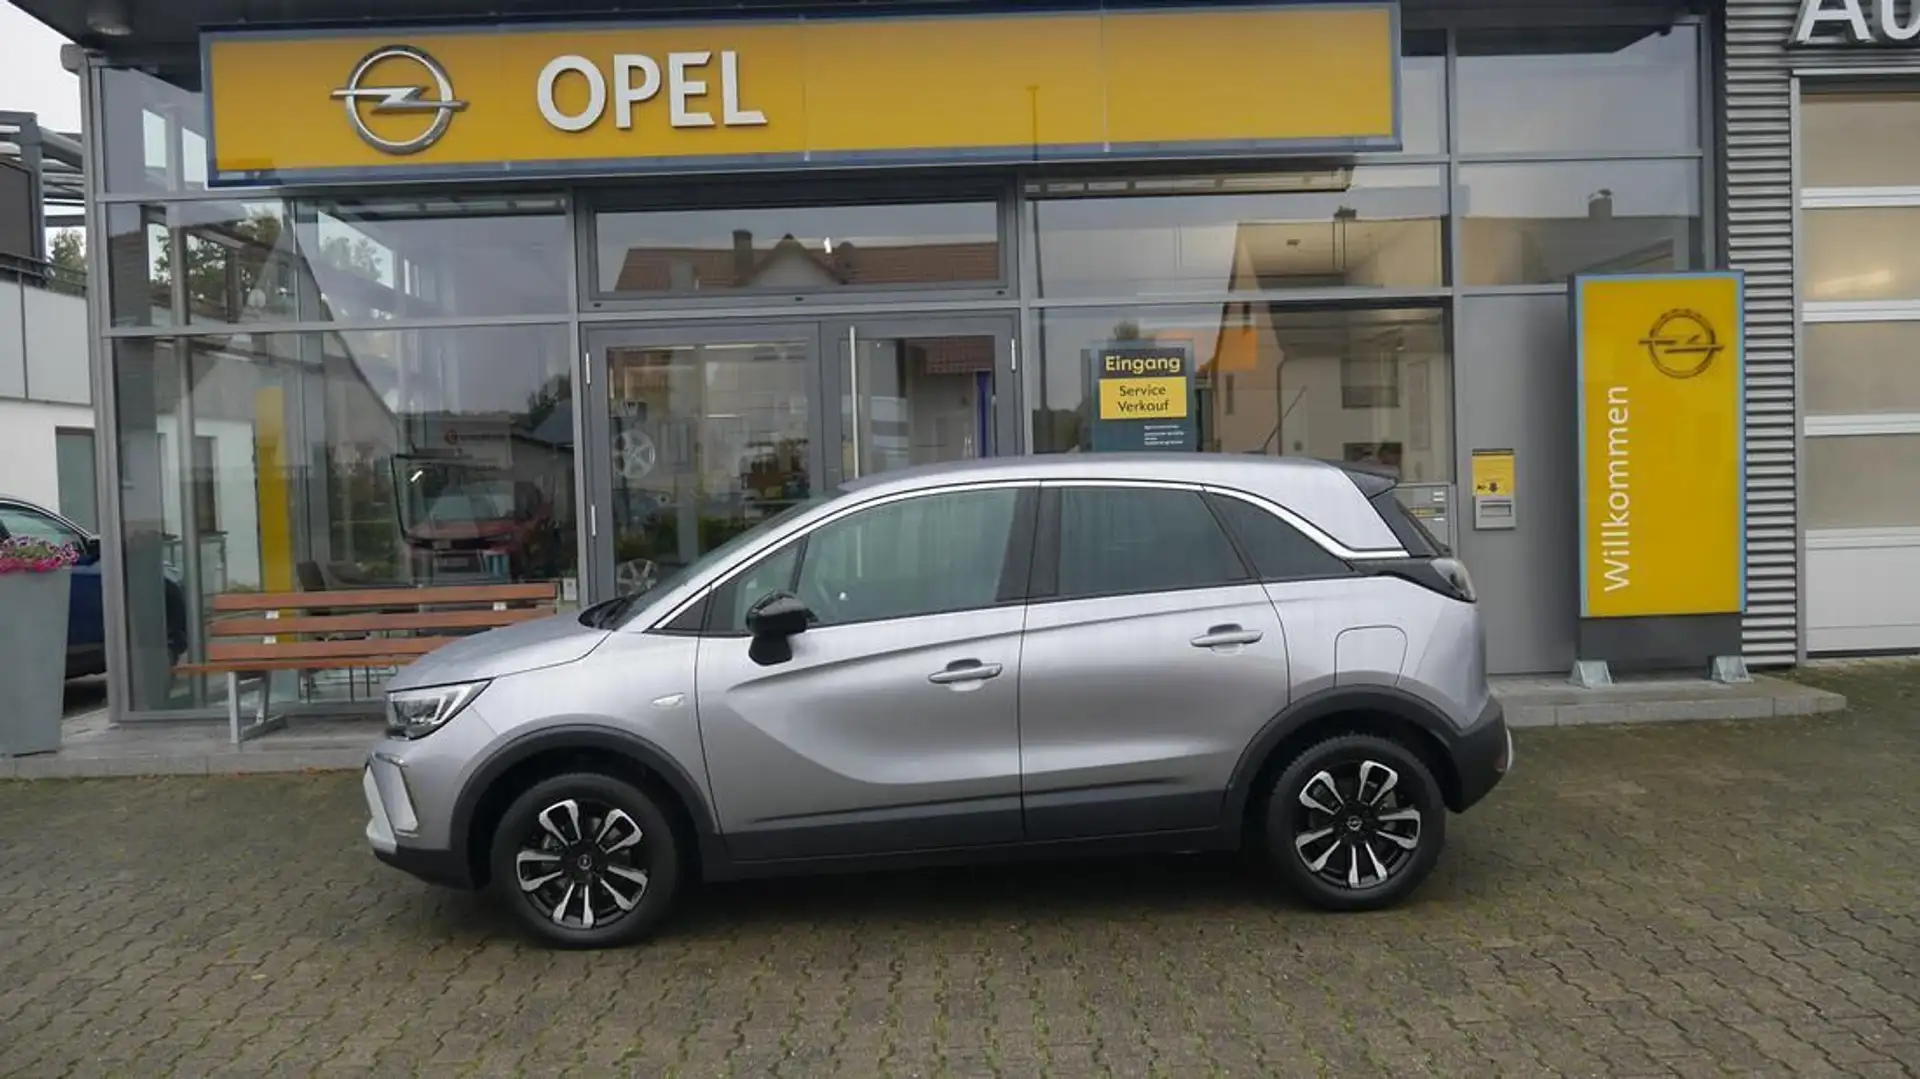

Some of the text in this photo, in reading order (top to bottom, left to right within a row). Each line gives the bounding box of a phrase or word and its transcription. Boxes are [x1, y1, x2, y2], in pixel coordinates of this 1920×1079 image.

[537, 50, 767, 132] OPEL
[1105, 355, 1180, 374] Eingang
[1120, 385, 1166, 397] Service
[1117, 400, 1169, 413] Verkauf
[1601, 385, 1630, 592] Willkommen
